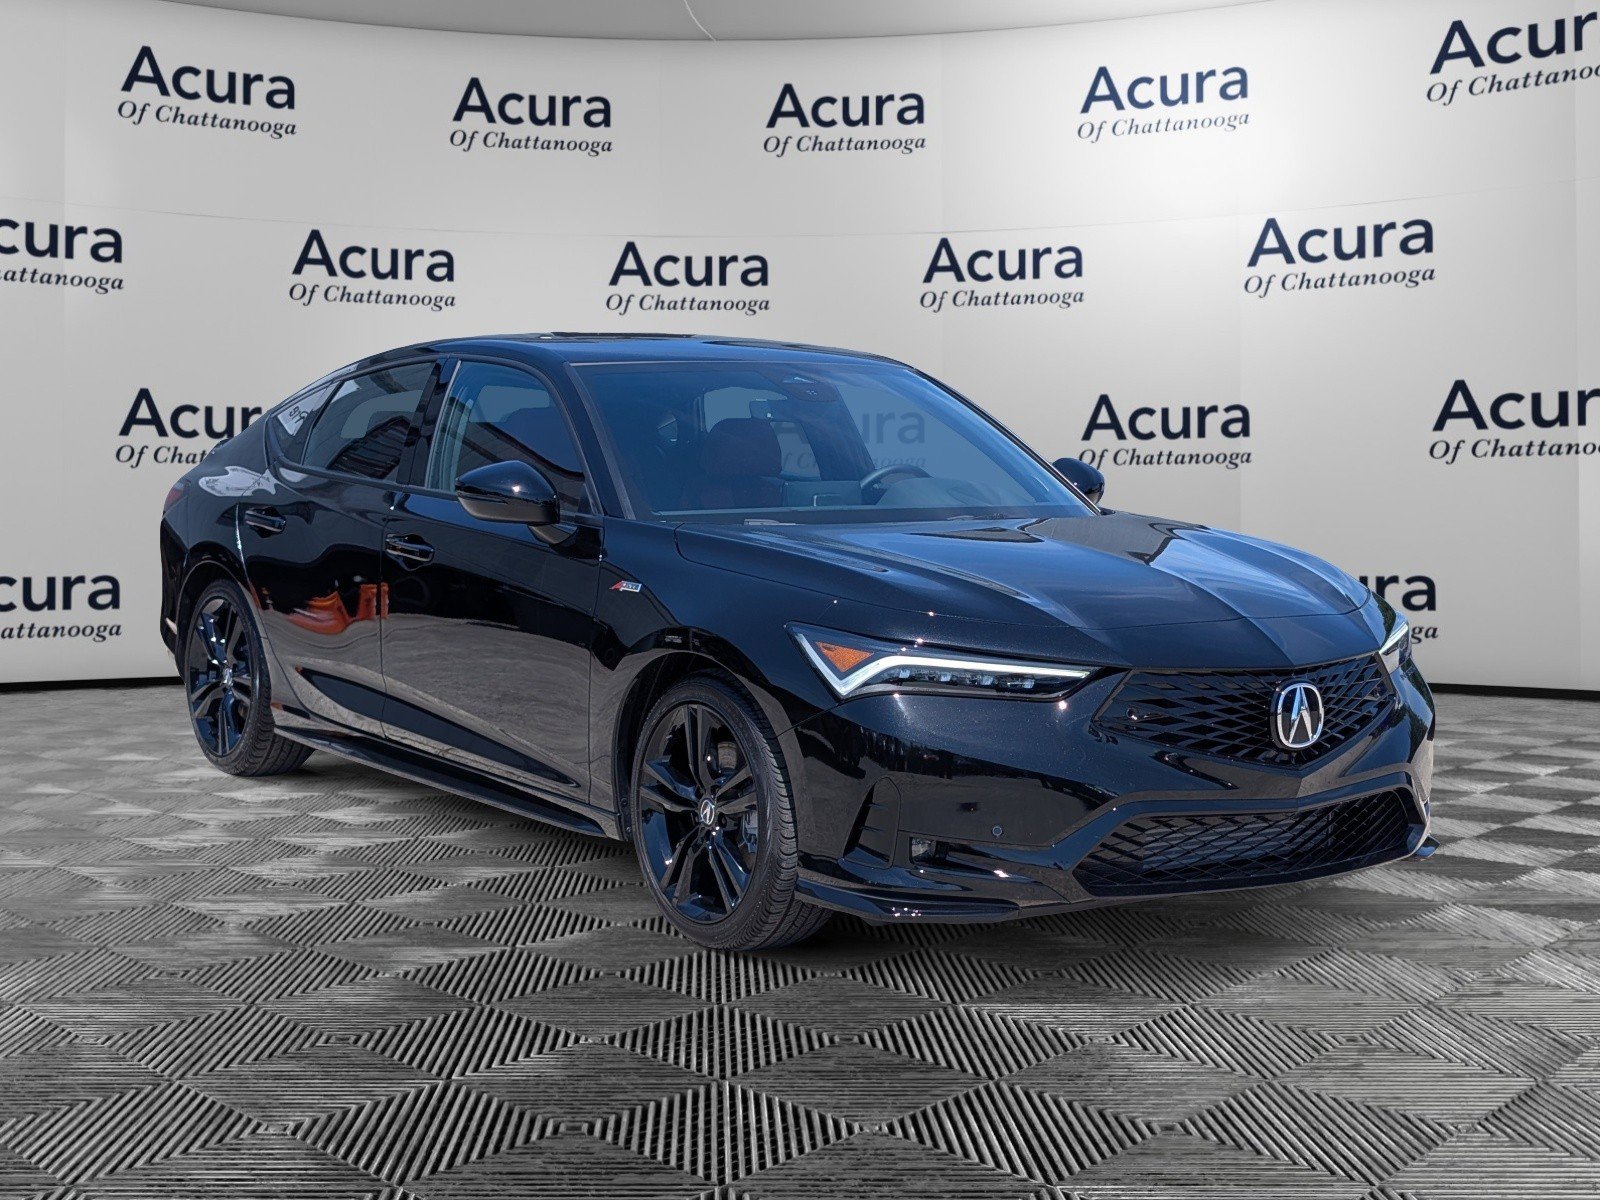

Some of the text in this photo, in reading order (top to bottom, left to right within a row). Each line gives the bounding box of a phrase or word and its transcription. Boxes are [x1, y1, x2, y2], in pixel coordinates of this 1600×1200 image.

[1429, 11, 1599, 75] Acur
[121, 45, 295, 110] Acura
[1080, 66, 1248, 114] Acura
[1426, 79, 1463, 106] Of
[118, 100, 297, 139] Of Chattanooga
[452, 77, 611, 128] Acura
[766, 83, 925, 128] Acura
[450, 129, 613, 157] Of Chattanooga
[763, 135, 926, 158] Of Chattanooga
[1077, 114, 1249, 143] Of Chattanooga
[0, 218, 122, 264] cura
[291, 229, 454, 282] Acura
[922, 237, 1083, 284] Acura
[1247, 218, 1433, 268] Acura
[609, 241, 768, 287] Acura
[1244, 269, 1435, 298] Of Chattanooga
[289, 283, 456, 312] Of Chattanooga
[606, 294, 770, 316] Of Chattanooga
[920, 289, 1084, 313] Of Chattanooga
[118, 388, 262, 439] Acur
[1081, 394, 1250, 441] Acura
[1432, 379, 1600, 432] Acur
[116, 444, 149, 469] Of
[1079, 448, 1252, 470] Of Chattanooga
[1429, 438, 1600, 465] Of Chattano
[0, 575, 120, 612] cura
[0, 622, 122, 643] attanooga
